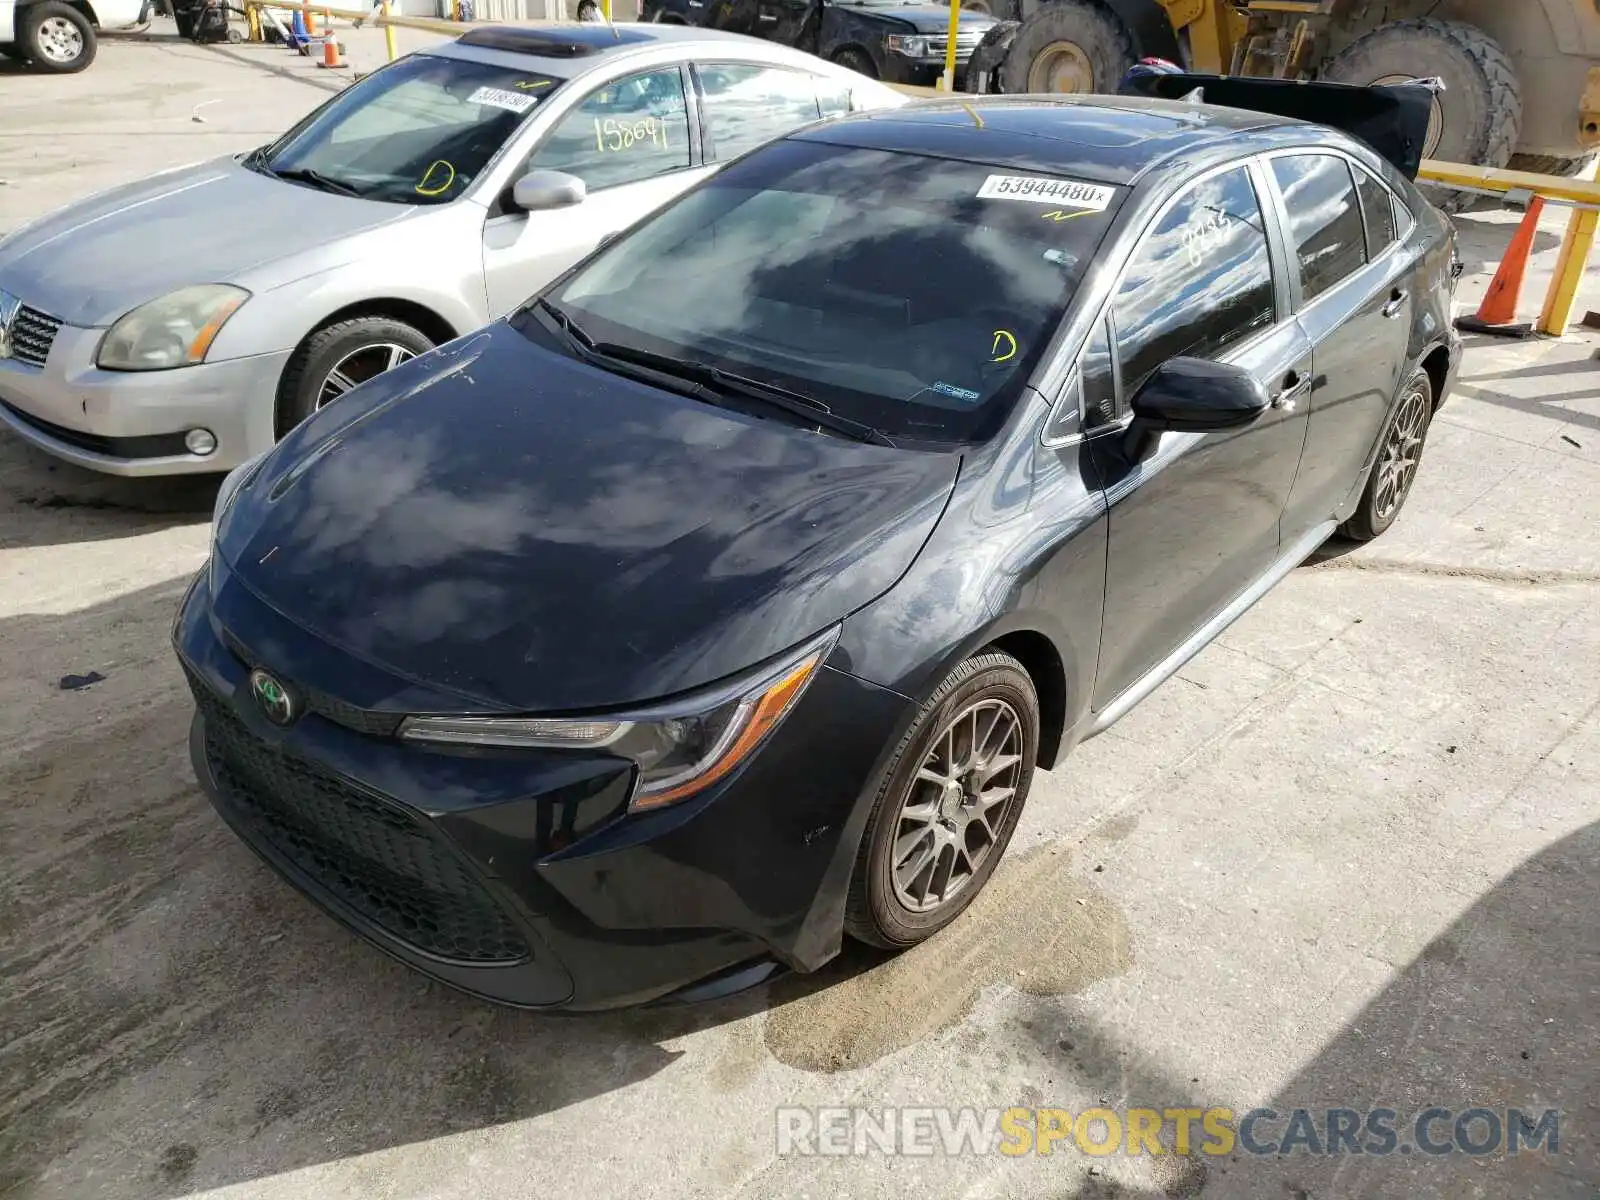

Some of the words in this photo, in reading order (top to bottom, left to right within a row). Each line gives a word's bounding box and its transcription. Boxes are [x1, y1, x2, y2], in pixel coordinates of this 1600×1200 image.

[415, 159, 455, 195] D
[997, 177, 1096, 202] 53944480
[989, 330, 1017, 362] D
